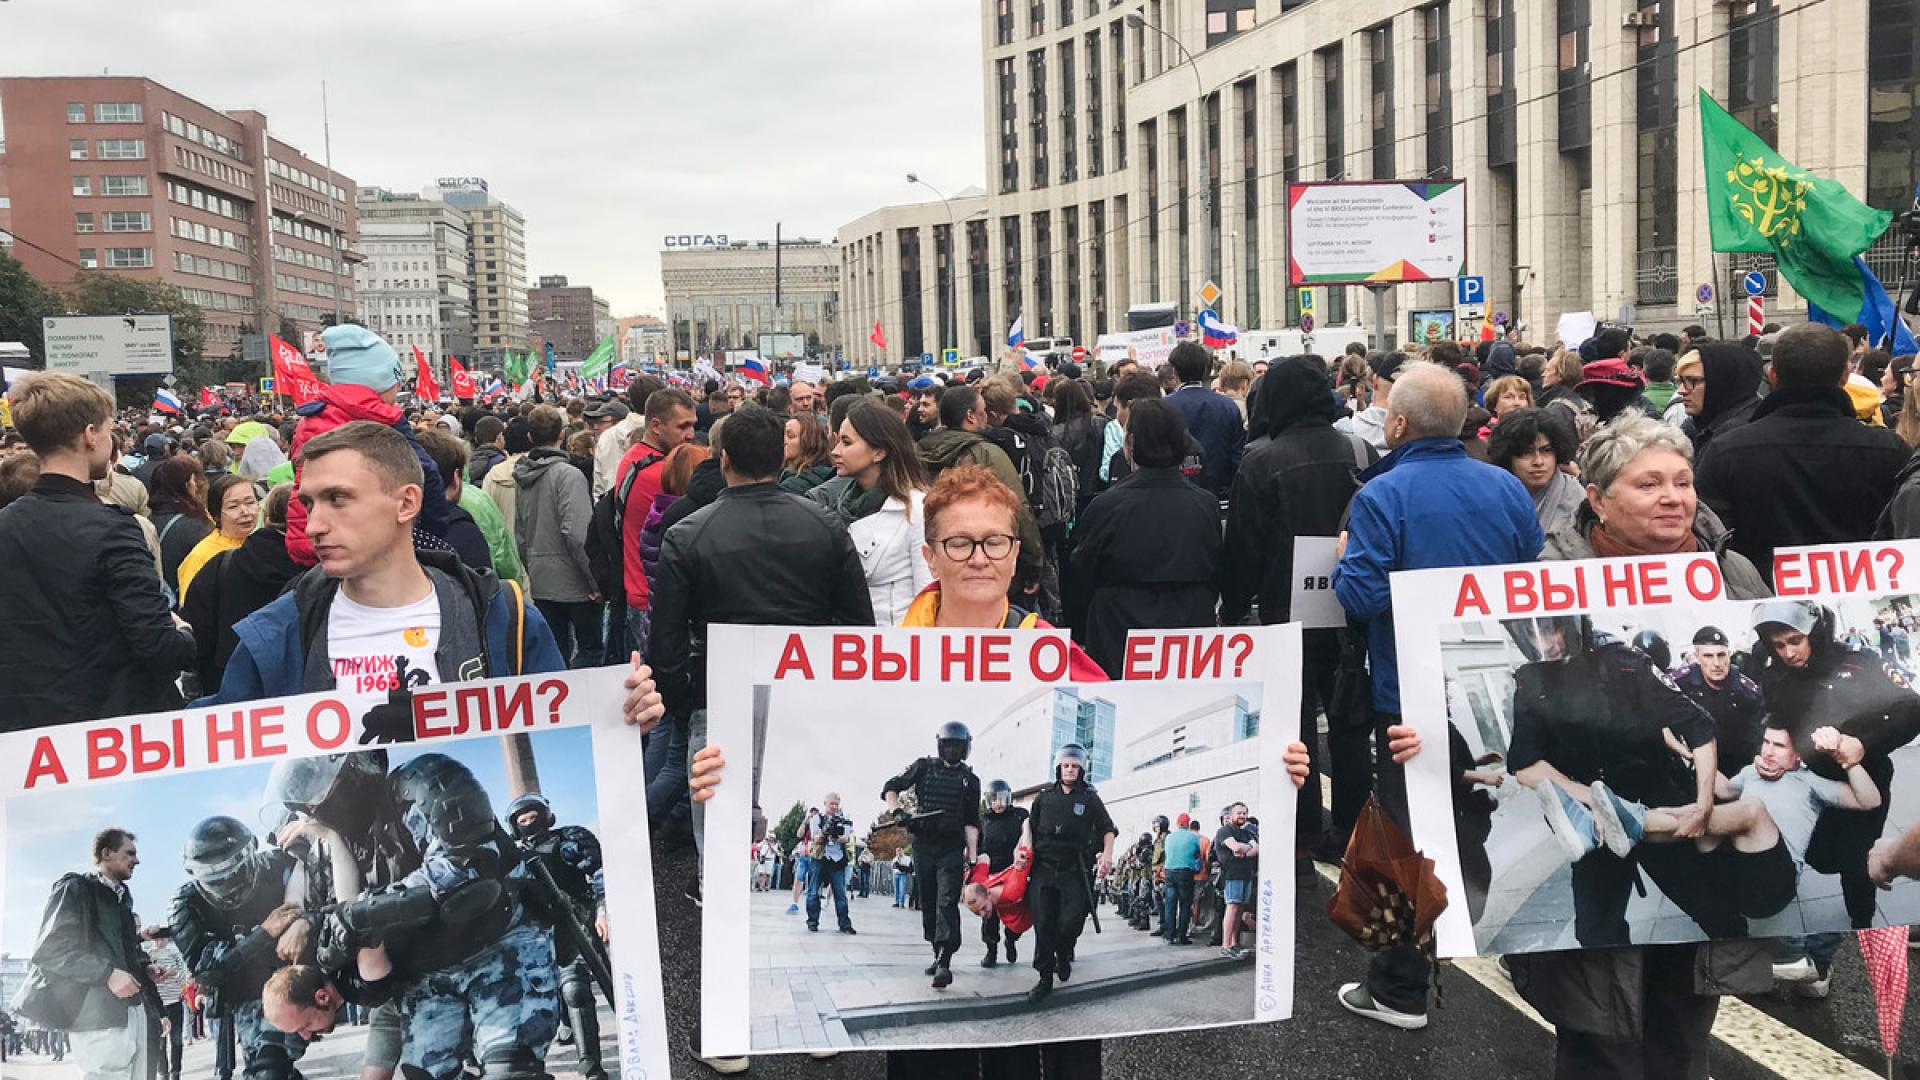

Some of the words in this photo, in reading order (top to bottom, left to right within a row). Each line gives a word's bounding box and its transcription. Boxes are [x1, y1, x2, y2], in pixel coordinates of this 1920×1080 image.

[664, 234, 728, 247] СОГАЗ
[1465, 279, 1480, 302] P
[1455, 573, 1490, 617] А
[1504, 566, 1587, 613] ВЫ
[1603, 562, 1671, 607] НЕ
[1774, 548, 1905, 597] ЕЛИ?
[333, 654, 395, 677] ПАРИЖ
[775, 633, 815, 680] А
[832, 633, 920, 681] ВЫ
[941, 634, 1011, 682] НЕ
[1124, 633, 1254, 681] ЕЛИ?
[356, 672, 400, 694] 1968
[24, 734, 68, 790] А
[87, 717, 185, 780] ВЫ
[207, 705, 288, 763] НЕ
[414, 680, 569, 738] ЕЛИ?
